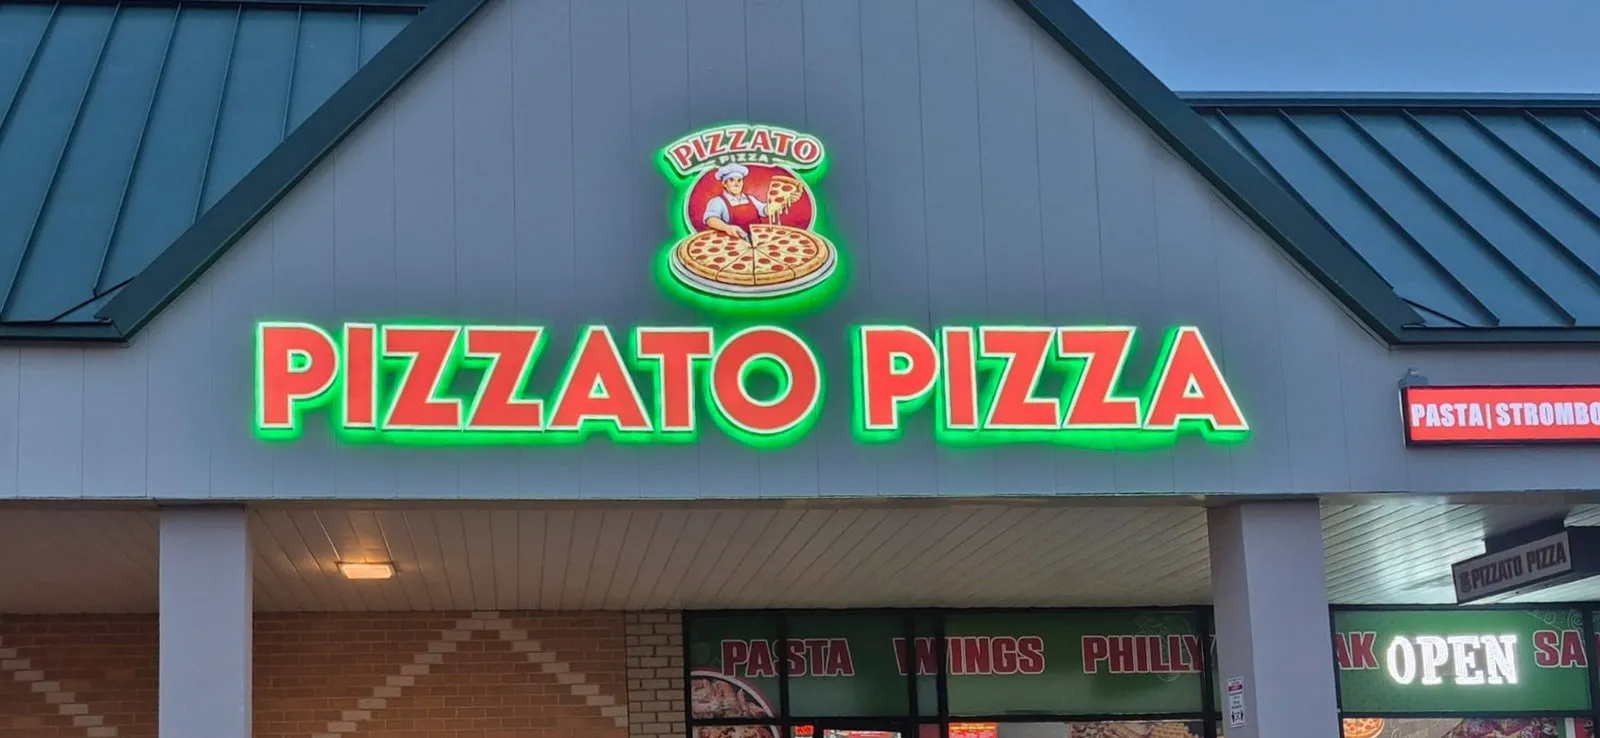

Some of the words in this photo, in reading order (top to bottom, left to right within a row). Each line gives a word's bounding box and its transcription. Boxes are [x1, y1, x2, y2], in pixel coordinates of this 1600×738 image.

[671, 128, 820, 168] PIZZATO
[718, 153, 770, 165] PIZZA
[257, 322, 821, 434] PIZZATO
[861, 325, 1249, 430] PIZZA
[1470, 554, 1524, 590] PIZZATO
[1526, 540, 1567, 573] PIZZA
[721, 637, 856, 678] PASTA
[892, 634, 1045, 676] WINGS
[1081, 633, 1217, 675] PHILLY
[1386, 634, 1519, 686] OPEN
[1533, 629, 1600, 669] SA
